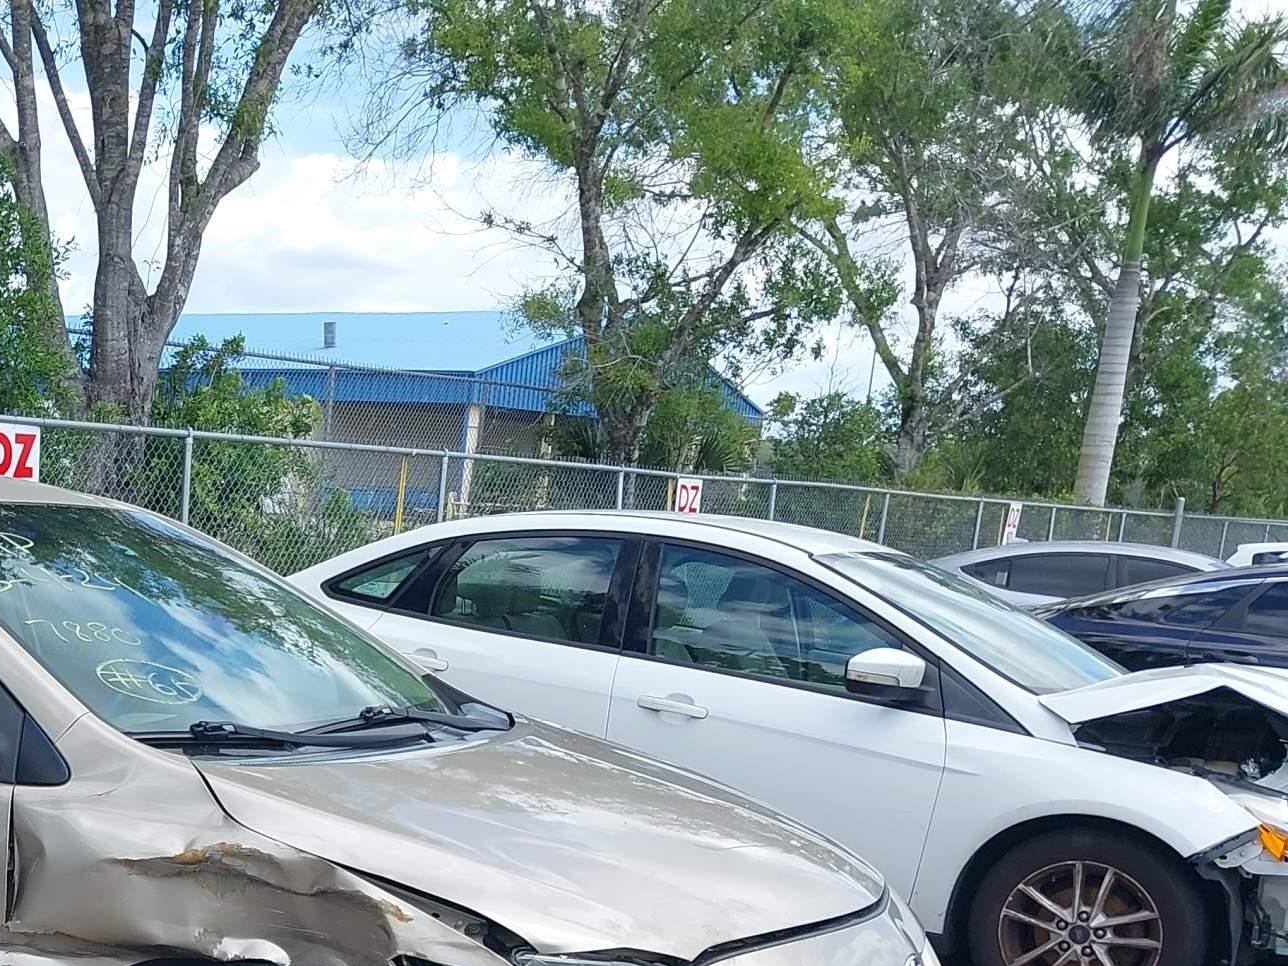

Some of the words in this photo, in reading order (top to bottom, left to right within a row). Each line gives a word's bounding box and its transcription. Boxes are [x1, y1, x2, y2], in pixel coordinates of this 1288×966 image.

[677, 484, 700, 514] DZ
[1007, 507, 1020, 529] DZ
[24, 618, 142, 646] 7880
